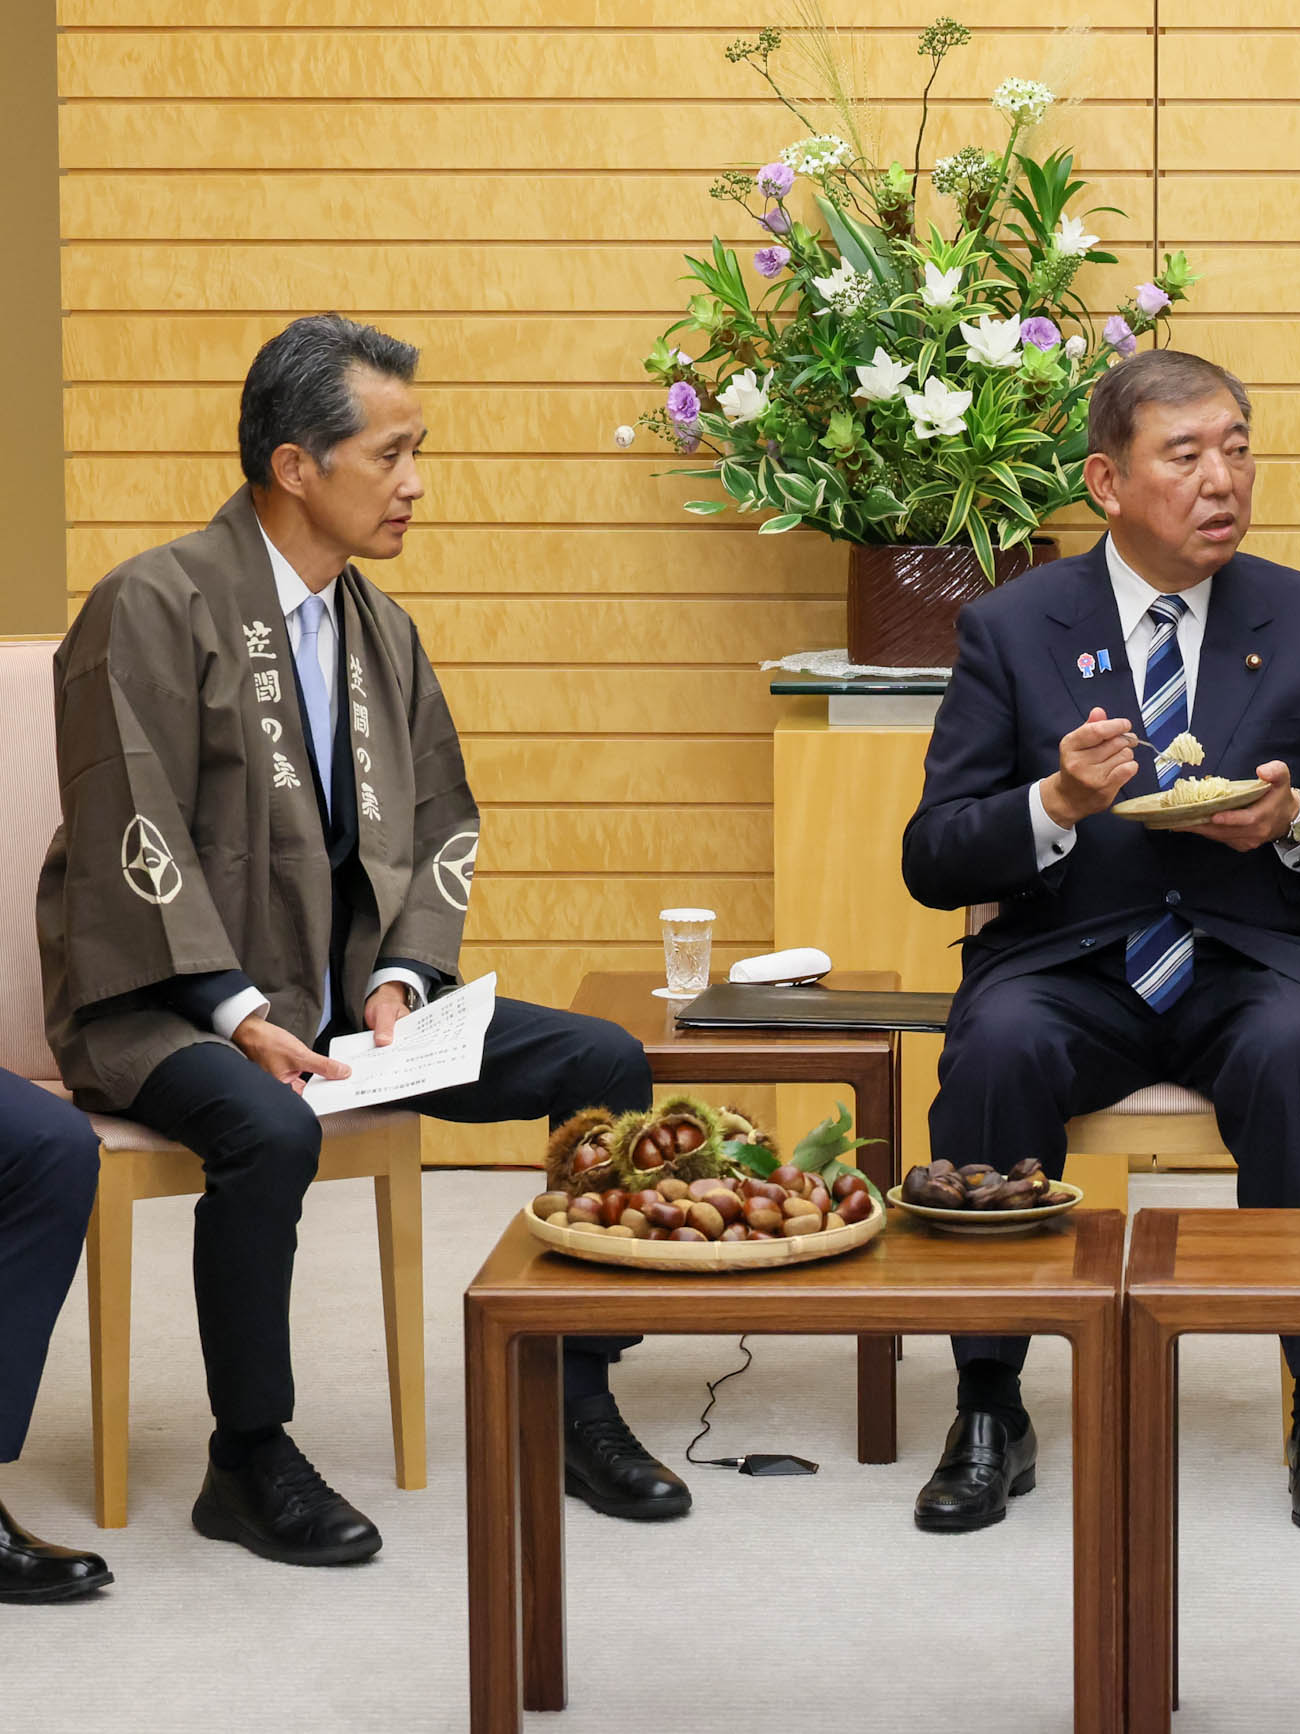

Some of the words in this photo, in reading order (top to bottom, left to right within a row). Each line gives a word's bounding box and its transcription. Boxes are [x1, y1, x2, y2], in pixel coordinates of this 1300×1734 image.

[242, 620, 302, 790] 笠間の栗
[349, 652, 382, 822] 笠間の栗
